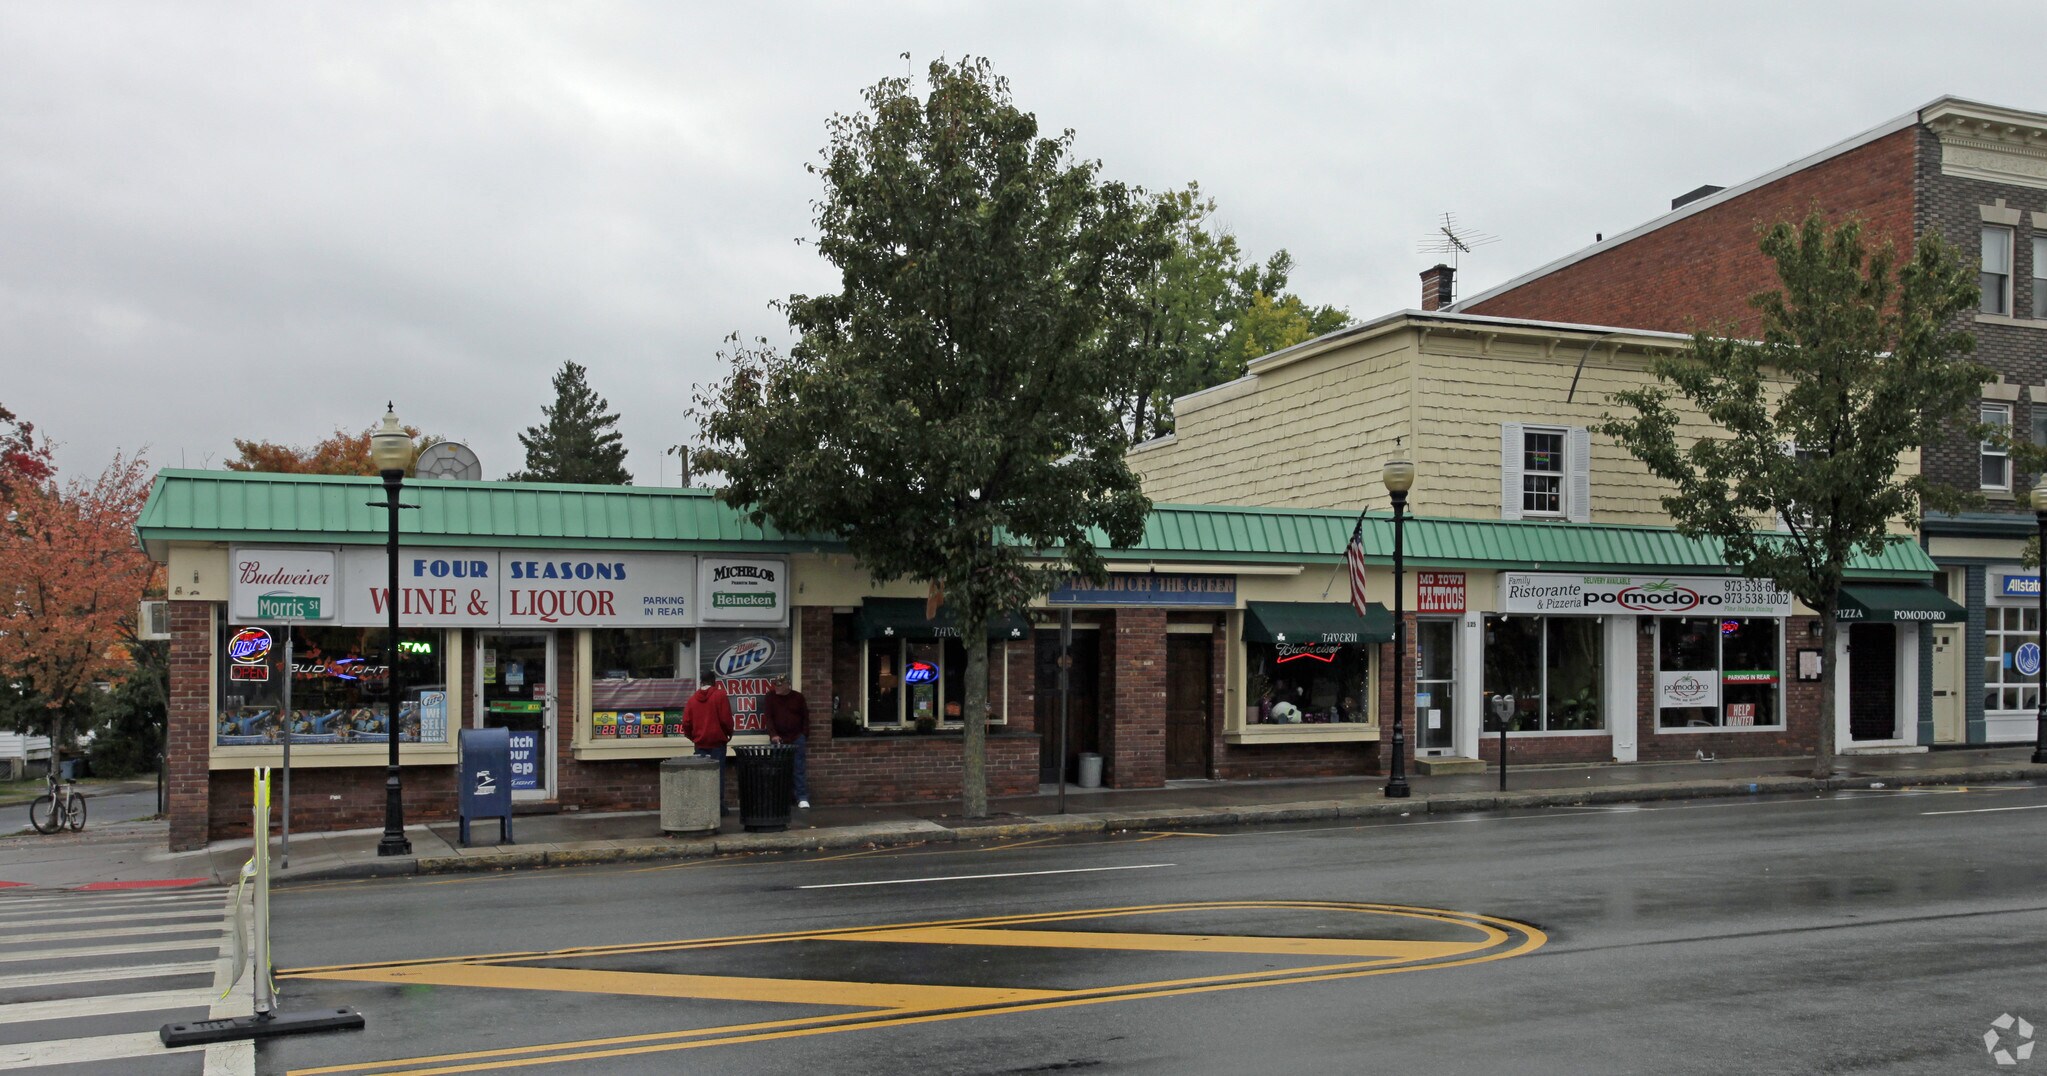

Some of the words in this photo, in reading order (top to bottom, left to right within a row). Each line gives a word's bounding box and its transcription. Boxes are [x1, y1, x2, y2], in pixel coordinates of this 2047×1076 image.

[239, 561, 330, 585] Budweiser
[414, 560, 488, 577] FOUR
[511, 561, 626, 580] SEASONS
[713, 566, 775, 582] MICHELOB
[1188, 577, 1234, 593] GREEN
[1420, 574, 1434, 584] MO
[1438, 575, 1464, 585] TOWN
[1509, 576, 1531, 586] Family
[1584, 577, 1605, 585] DELIVERY
[1420, 586, 1464, 609] TATTOOS
[1509, 584, 1581, 598] Ristorante
[643, 596, 684, 604] PARKING
[717, 595, 772, 605] Heineken
[1536, 601, 1543, 609] &
[1546, 598, 1582, 609] Pizzeria
[1584, 590, 1722, 606] pomodoro
[260, 599, 304, 616] Morris
[309, 600, 319, 609] St
[369, 588, 457, 614] WINE
[467, 589, 489, 615] &
[510, 589, 616, 623] LIQUOR
[1894, 610, 1946, 620] POMODORO
[1322, 633, 1358, 642] TAVERN
[726, 648, 768, 675] Lite
[232, 666, 267, 679] OPEN
[1664, 680, 1709, 694] pomodoro
[737, 697, 757, 712] IN
[1733, 704, 1750, 716] HELP
[421, 719, 446, 730] SELL
[1727, 716, 1754, 726] WANTED
